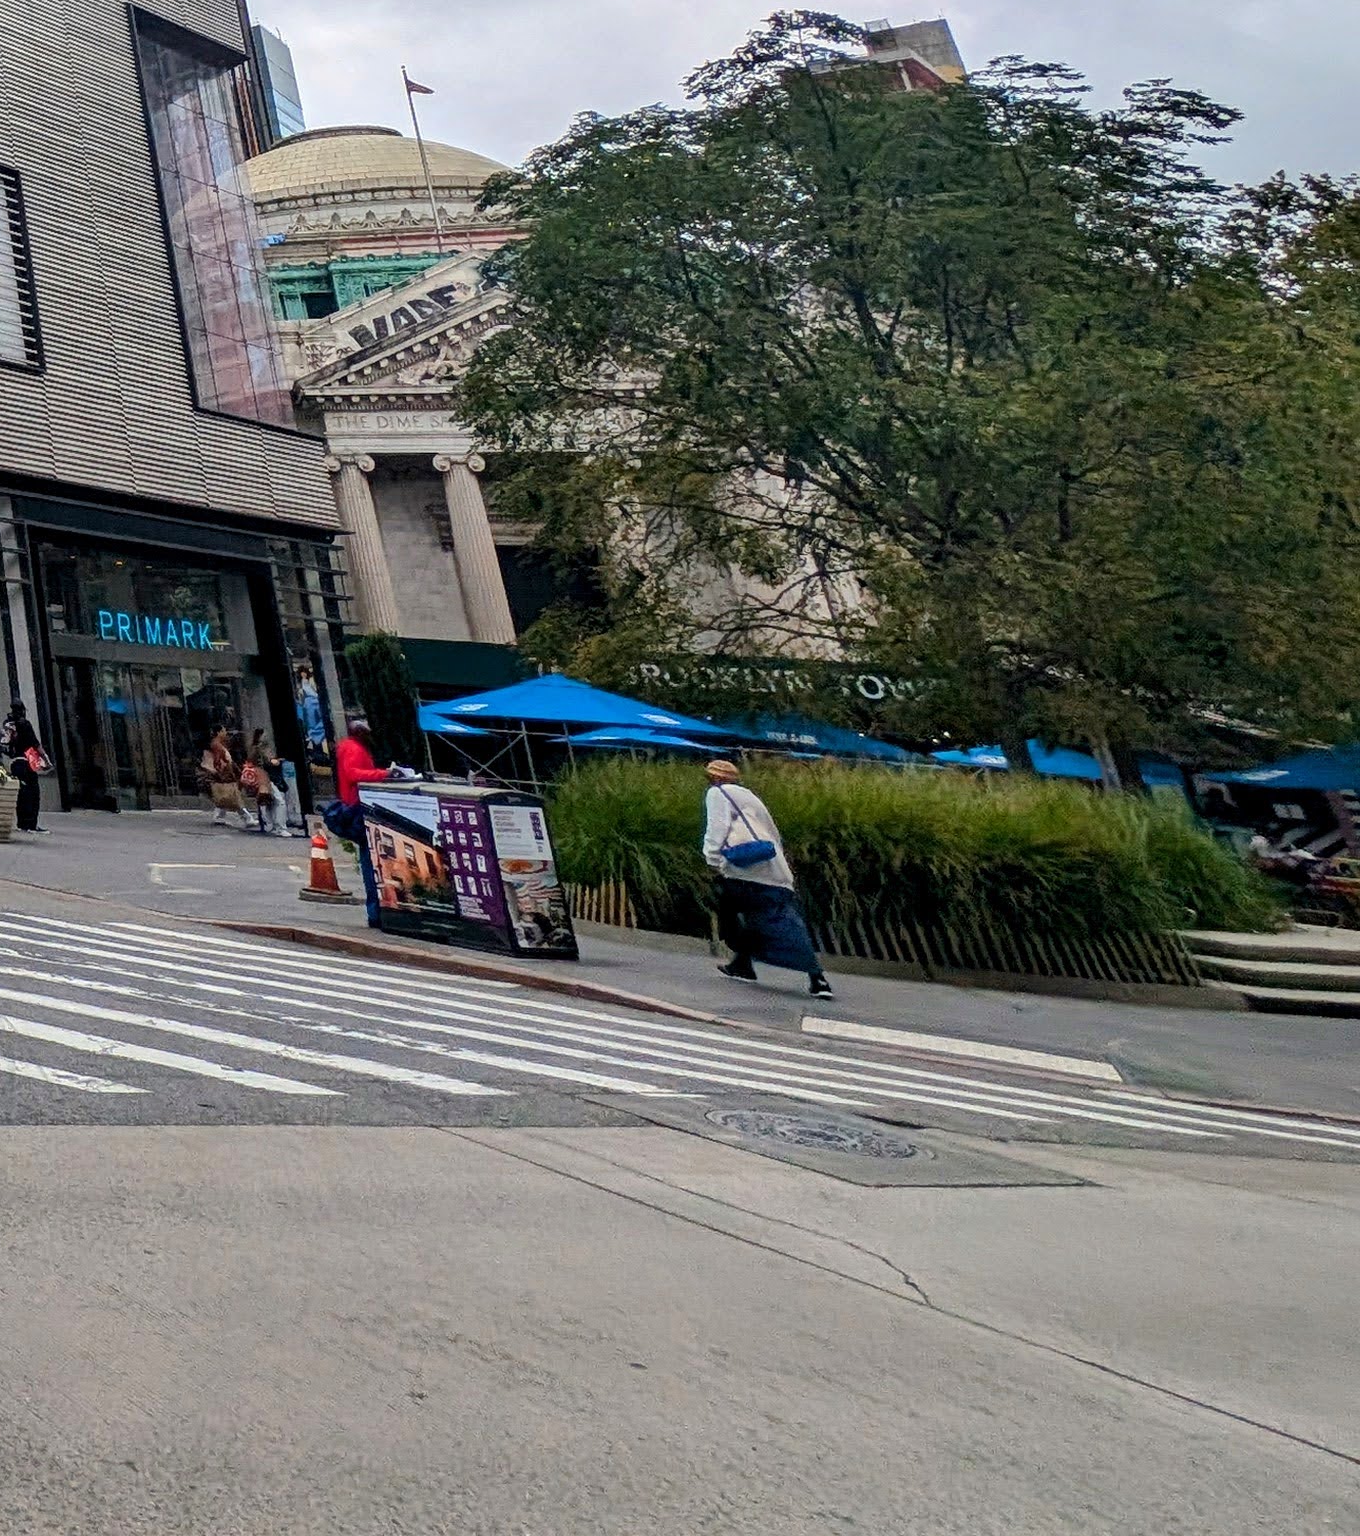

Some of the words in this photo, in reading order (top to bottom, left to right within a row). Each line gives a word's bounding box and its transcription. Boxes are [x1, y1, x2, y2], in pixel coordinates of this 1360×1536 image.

[333, 414, 371, 429] THE
[376, 414, 424, 429] DIME
[98, 609, 214, 651] PRIMARK
